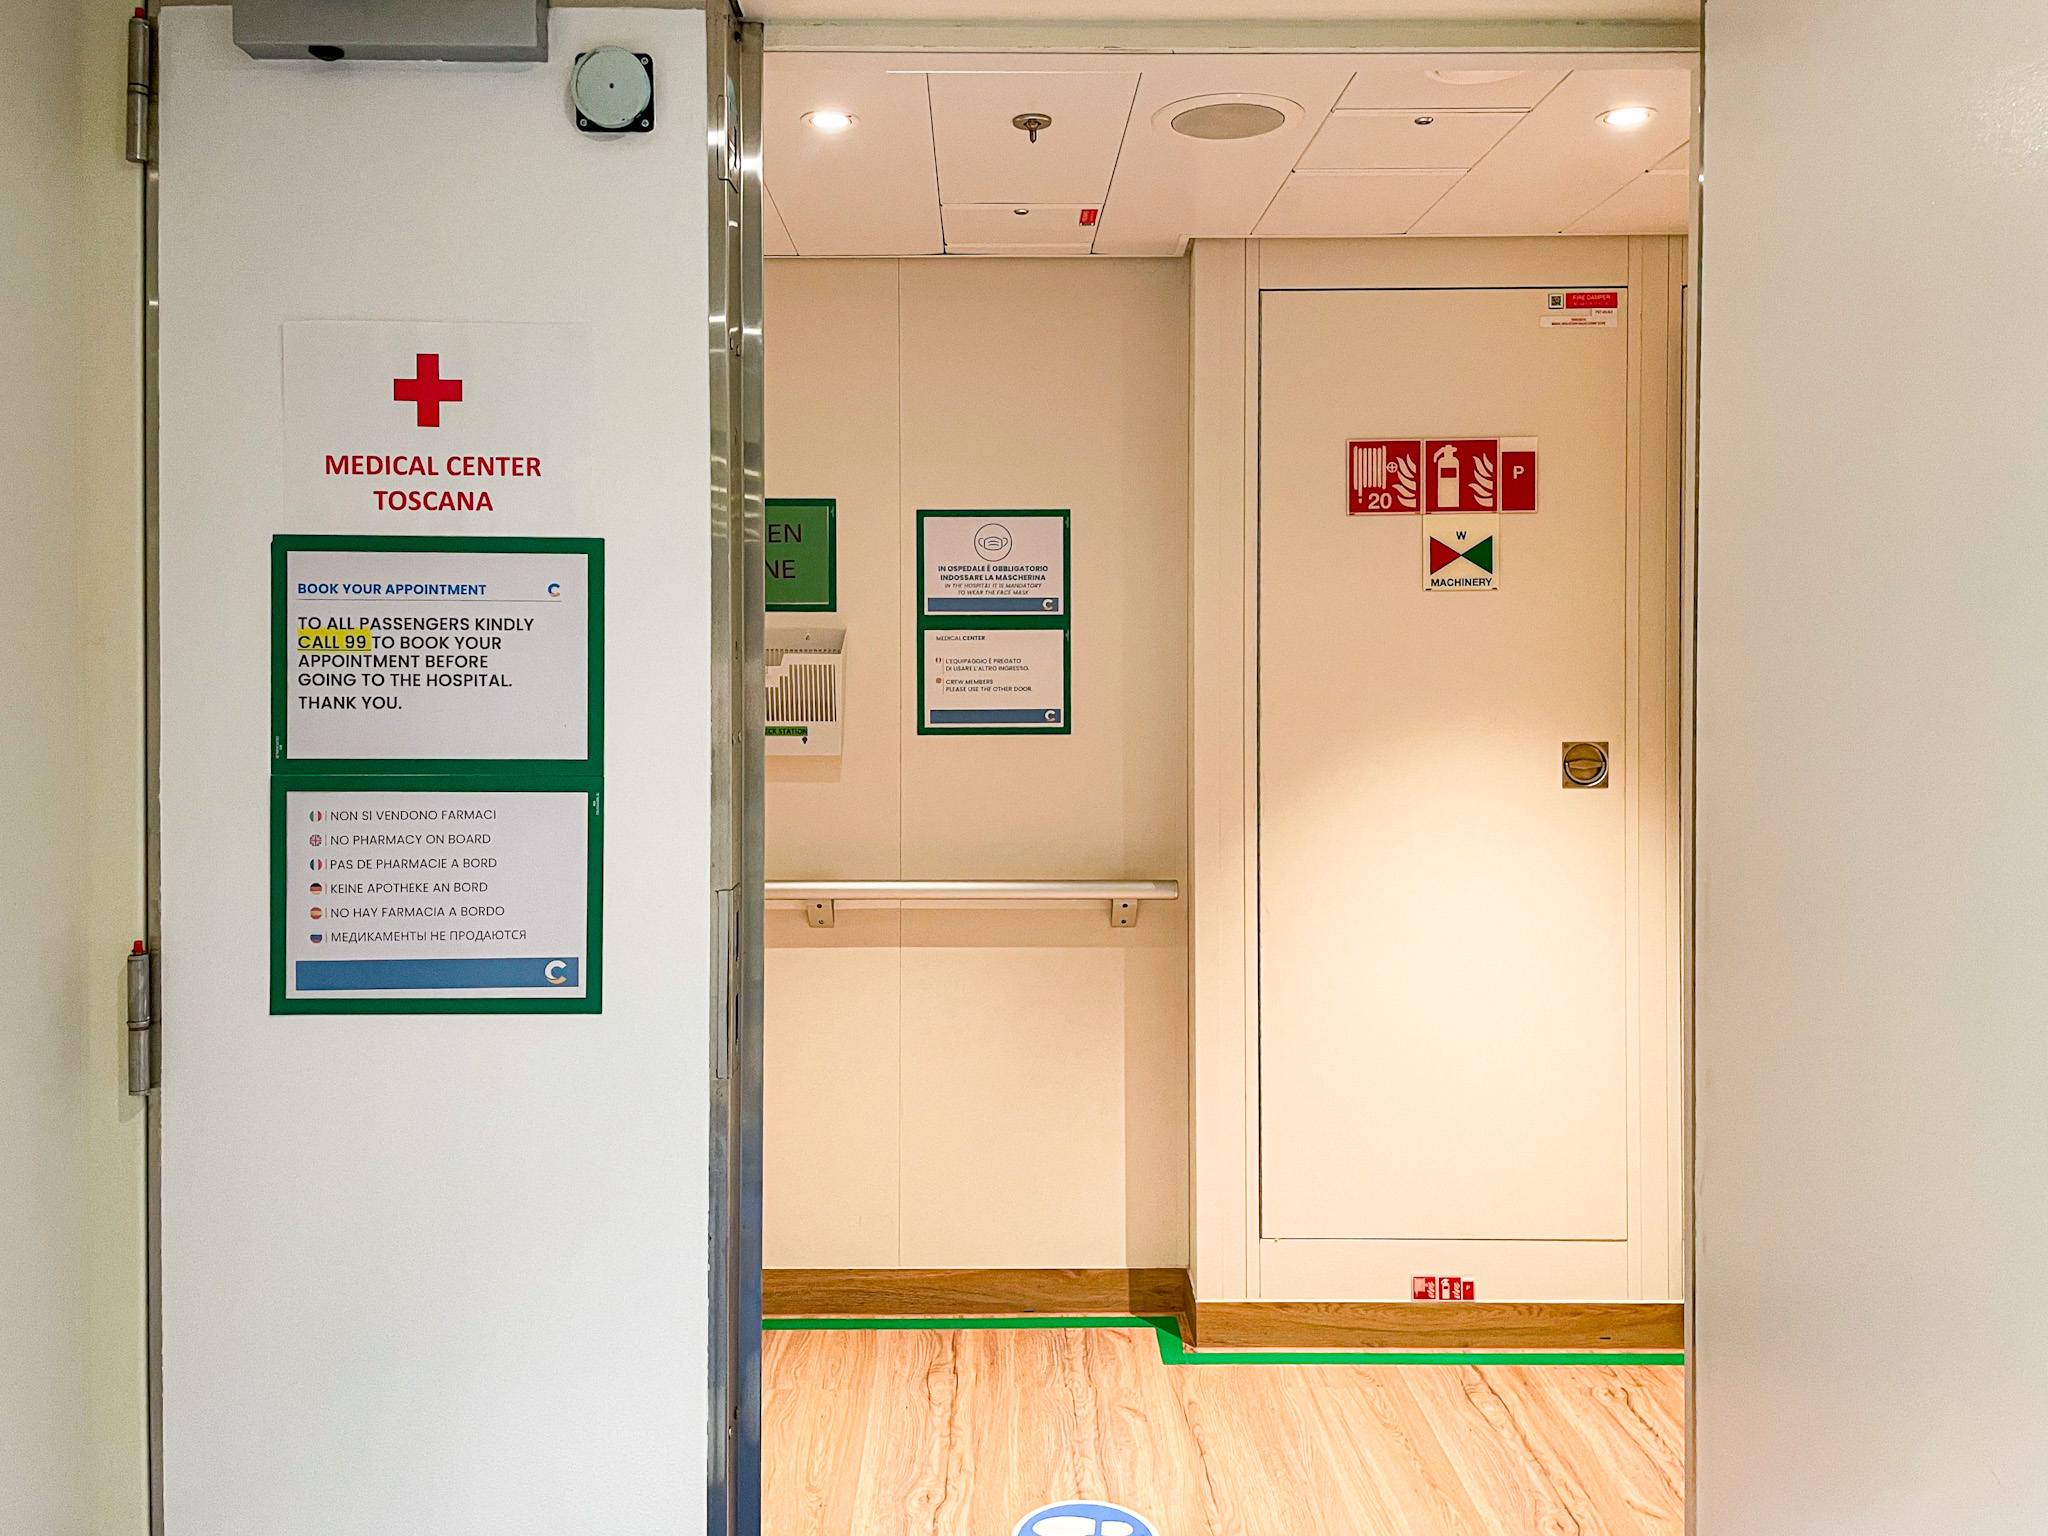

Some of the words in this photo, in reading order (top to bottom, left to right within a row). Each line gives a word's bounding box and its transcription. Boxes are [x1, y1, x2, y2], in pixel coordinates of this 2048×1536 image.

[325, 455, 439, 476] MEDICAL
[446, 456, 542, 477] CENTER
[1513, 466, 1524, 479] P
[373, 490, 494, 512] TOSCANA
[1368, 493, 1392, 509] 20
[1456, 531, 1467, 541] W
[1430, 578, 1493, 587] MACHINERY
[297, 583, 339, 595] BOOK
[342, 583, 382, 595] YOUR
[385, 584, 487, 596] APPOINTMENT
[297, 616, 322, 631] TO
[326, 616, 355, 631] ALL
[360, 617, 470, 631] PASSENGERS
[475, 617, 535, 632] KINDLY
[297, 634, 341, 650] CALL
[345, 636, 367, 650] 99
[372, 636, 395, 650] TO
[400, 636, 450, 650] BOOK
[455, 636, 502, 650] YOUR
[298, 654, 420, 668] APPOINTMENT
[425, 655, 488, 668] BEFORE
[298, 673, 357, 687] GOING
[361, 673, 385, 687] TO
[389, 673, 421, 687] THE
[426, 673, 513, 688] HOSPITAL.
[298, 696, 357, 710] THANK
[361, 696, 402, 710] YOU.
[330, 810, 358, 821] NON
[361, 810, 372, 821] SI
[375, 810, 438, 821] VENDONO
[441, 809, 496, 820] FARMACI
[330, 835, 350, 846] NO
[353, 835, 423, 846] PHARMACY
[426, 834, 445, 845] ON
[448, 833, 491, 845] BOARD
[330, 859, 354, 870] PAS
[357, 858, 373, 870] DE
[376, 858, 447, 869] PHARMACIE
[450, 858, 459, 868] A
[463, 857, 497, 869] BORD
[330, 884, 364, 894] KEINE
[367, 883, 429, 894] APOTHEKE
[432, 882, 450, 893] AN
[454, 882, 488, 893] BORD
[330, 908, 350, 918] NO
[353, 907, 378, 918] HAY
[381, 907, 445, 918] FARMACIA
[448, 907, 457, 917] A
[460, 906, 505, 917] BORDO
[331, 931, 427, 944] МЕДИКАМЕНТЫ
[430, 931, 446, 942] НЕ
[449, 929, 527, 942] ПРОДАЮТСЯ
